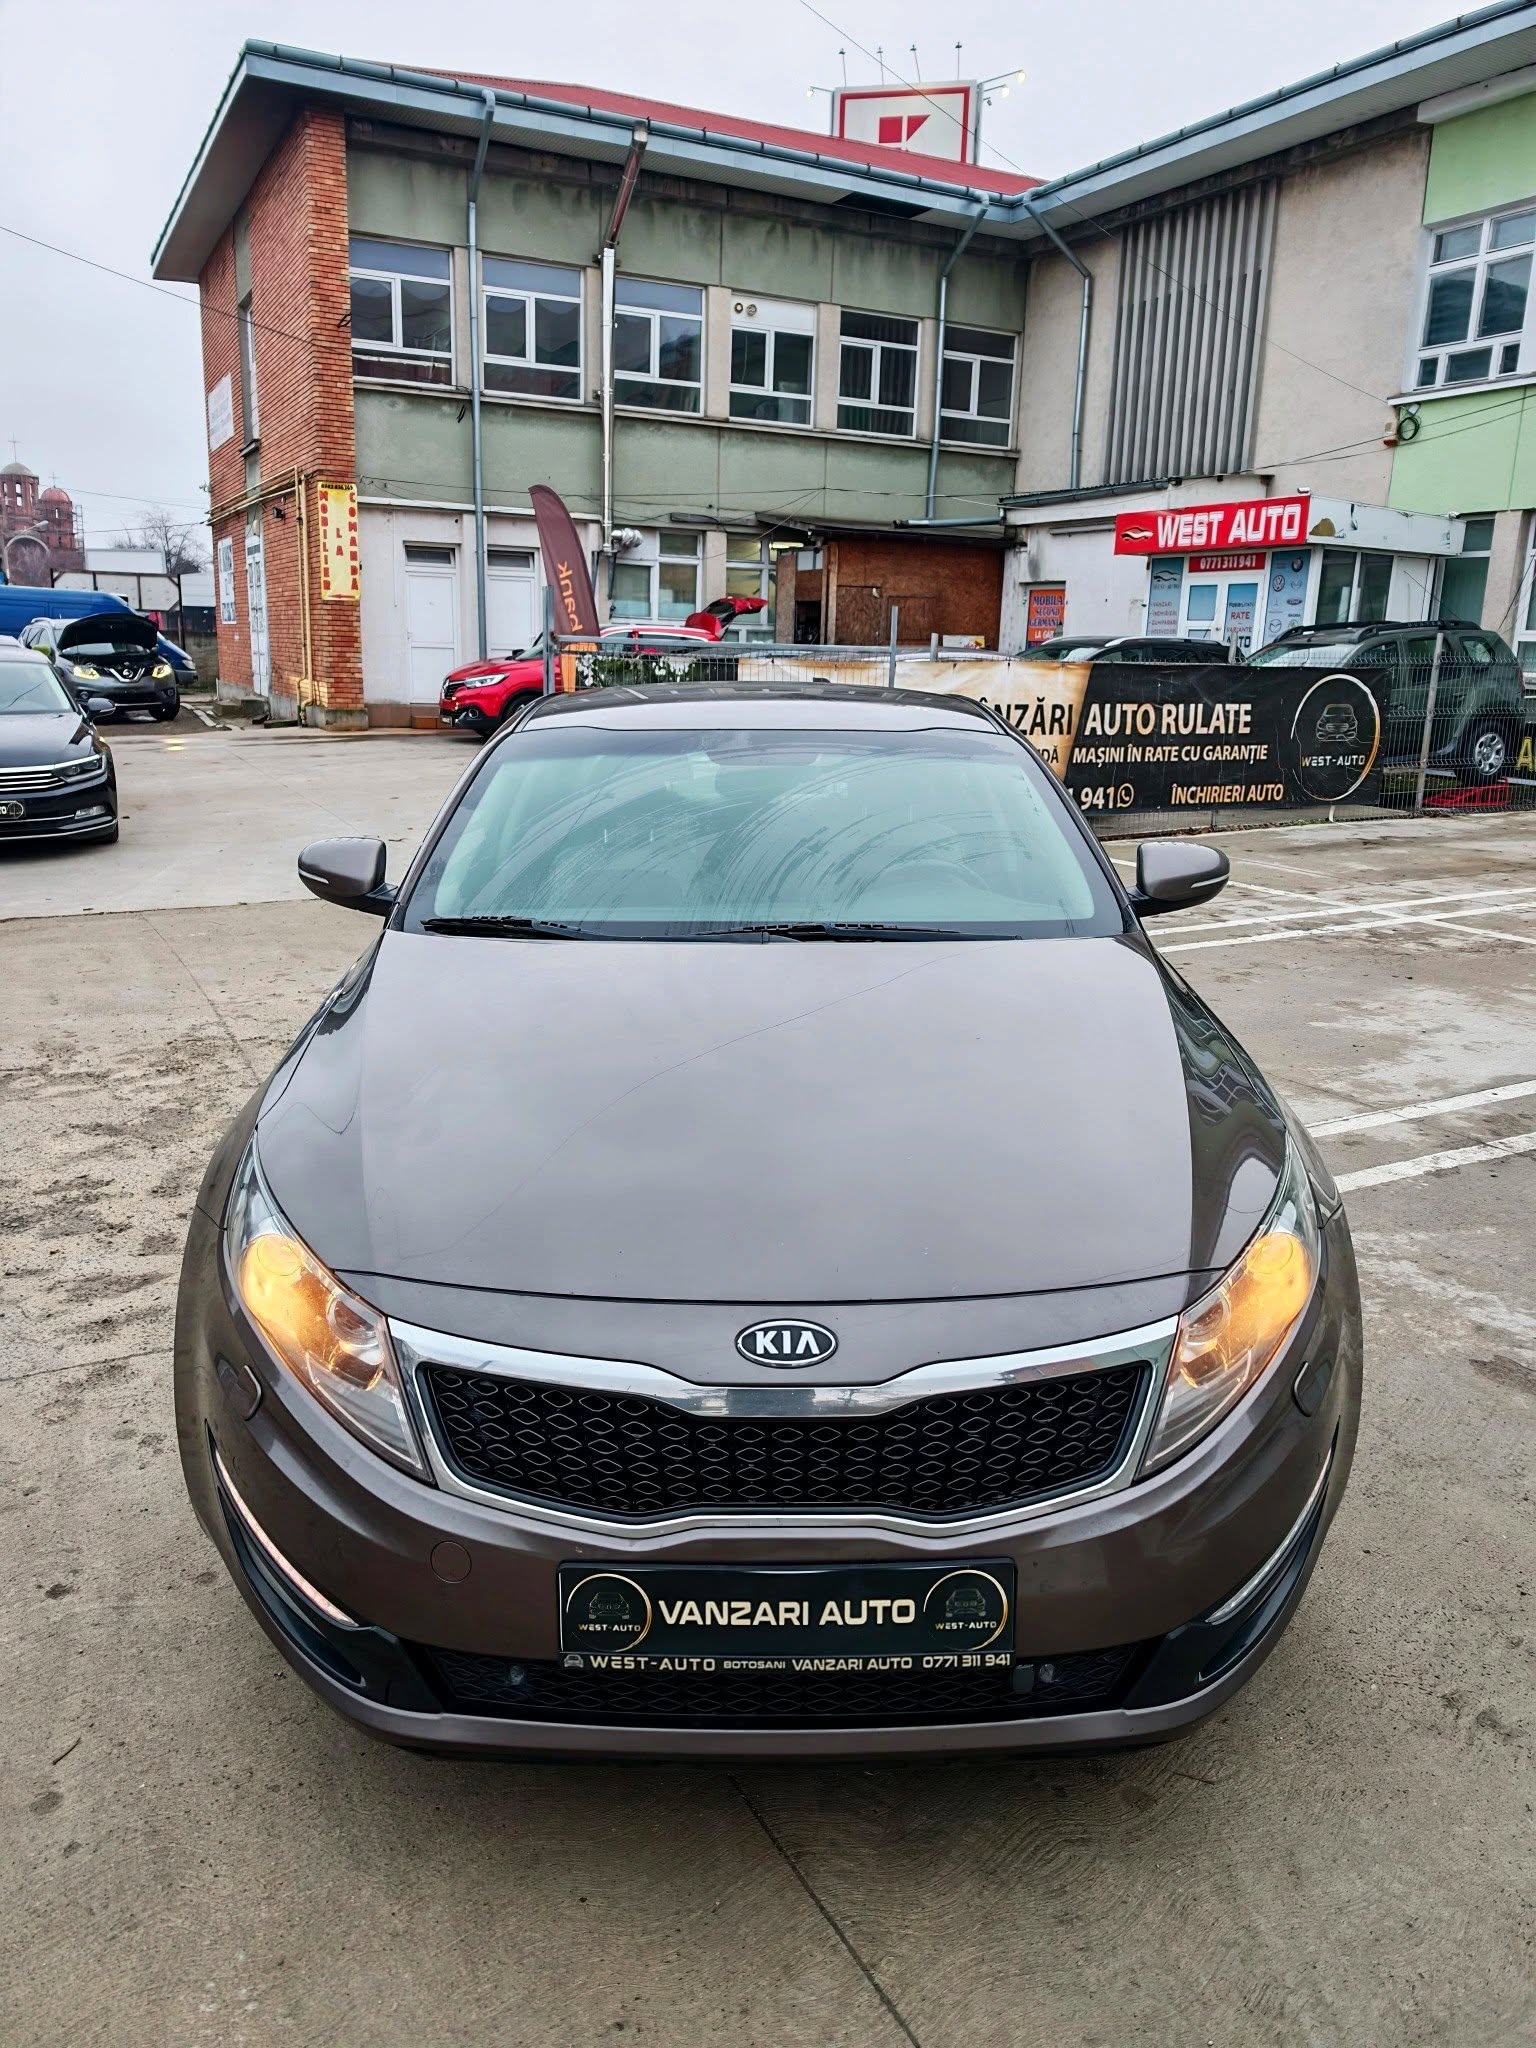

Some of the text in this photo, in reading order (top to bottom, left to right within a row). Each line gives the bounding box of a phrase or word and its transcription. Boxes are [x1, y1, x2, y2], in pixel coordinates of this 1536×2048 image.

[1157, 503, 1302, 548] WEST AUTO
[319, 491, 331, 590] MOBILIER
[336, 528, 344, 556] LA
[1033, 595, 1063, 606] MOBILA
[1231, 611, 1250, 619] RATE
[1034, 631, 1042, 639] LA
[1084, 703, 1156, 736] AUTO
[1161, 703, 1252, 735] RULATE
[1072, 747, 1124, 767] MAȘINI
[1127, 743, 1144, 762] ÎN
[1145, 745, 1179, 762] RATE
[1181, 746, 1201, 761] CU
[1203, 744, 1268, 764] GARANȚIE
[1301, 755, 1366, 767] WEST-AUTO
[1080, 786, 1115, 810] 941
[1171, 783, 1244, 805] ÎNCHIRIERI
[1247, 784, 1284, 801] AUTO
[754, 1330, 820, 1354] KIA
[658, 1599, 916, 1626] VANZARI AUTO
[578, 1624, 641, 1632] WEST-AUTO
[935, 1620, 997, 1630] WEST-AUTO
[590, 1653, 1011, 1671] WEST-AUTO BOTOSANI VANZARI AUTO 0771 311 941
